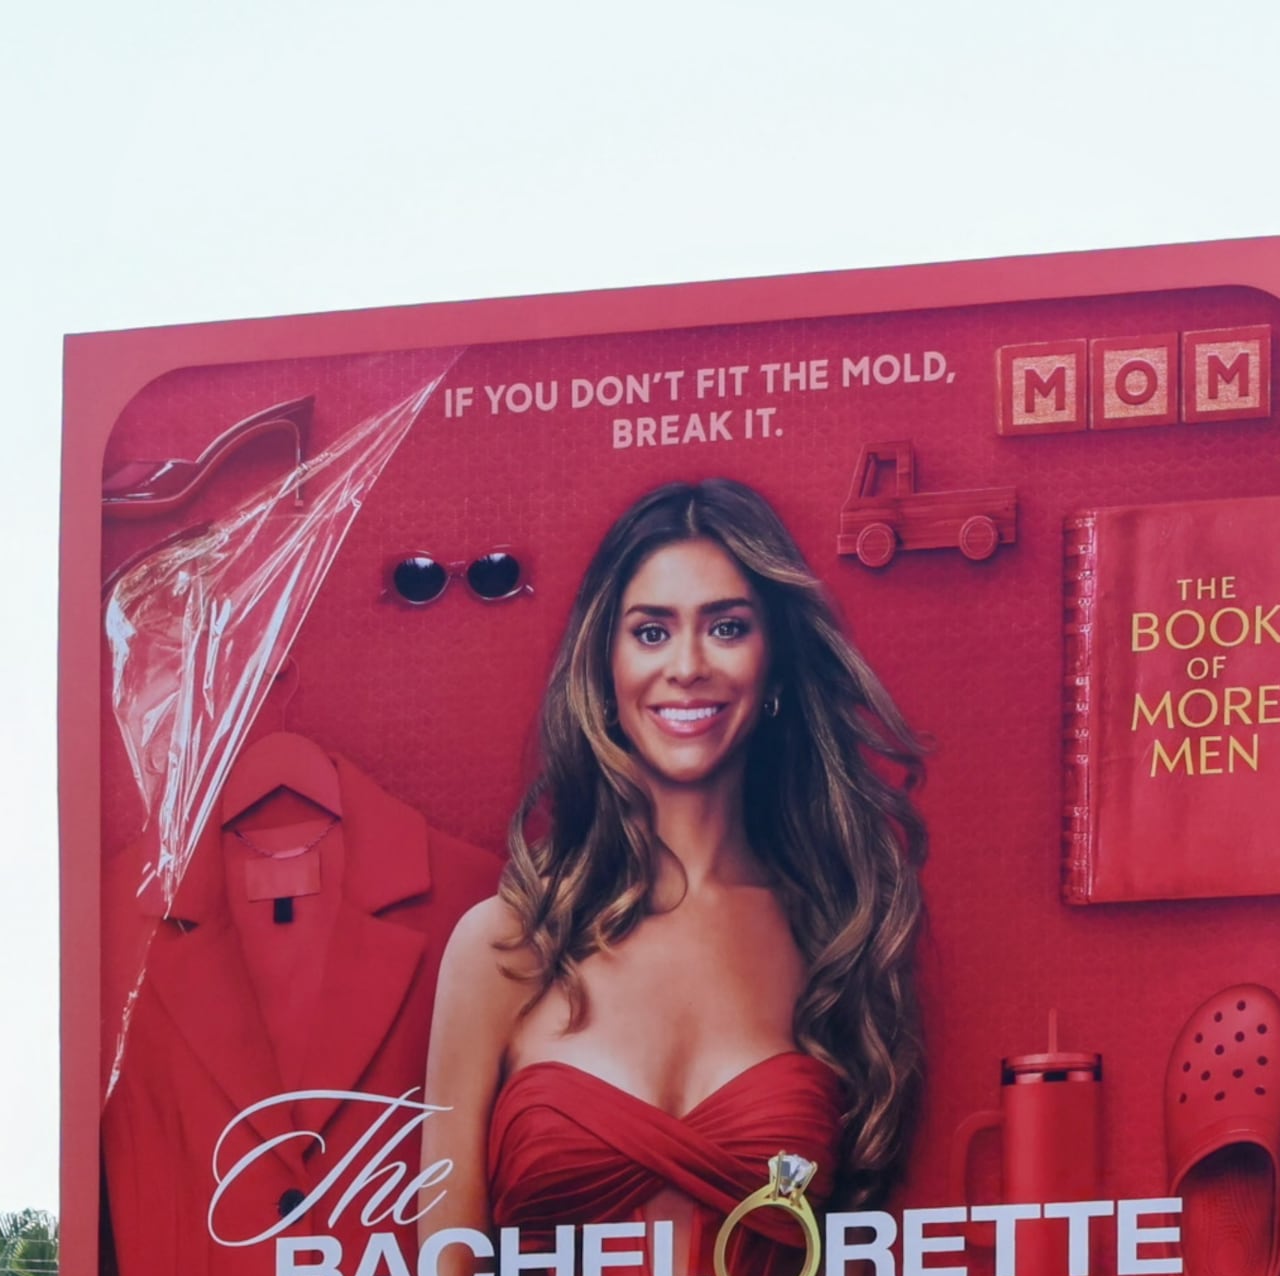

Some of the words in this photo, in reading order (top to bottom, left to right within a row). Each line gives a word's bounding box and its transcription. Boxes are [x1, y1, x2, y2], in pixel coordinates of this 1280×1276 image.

[444, 386, 474, 418] IF
[484, 380, 558, 414] YOU
[571, 369, 685, 409] DON'T
[697, 365, 750, 399] FIT
[760, 359, 829, 393] THE
[842, 351, 957, 386] MOLD,
[612, 410, 734, 449] BREAK
[744, 407, 784, 439] IT.
[1176, 576, 1237, 601] THE
[1186, 655, 1227, 680] OF
[1150, 733, 1259, 778] MEN
[207, 1086, 454, 1247] The
